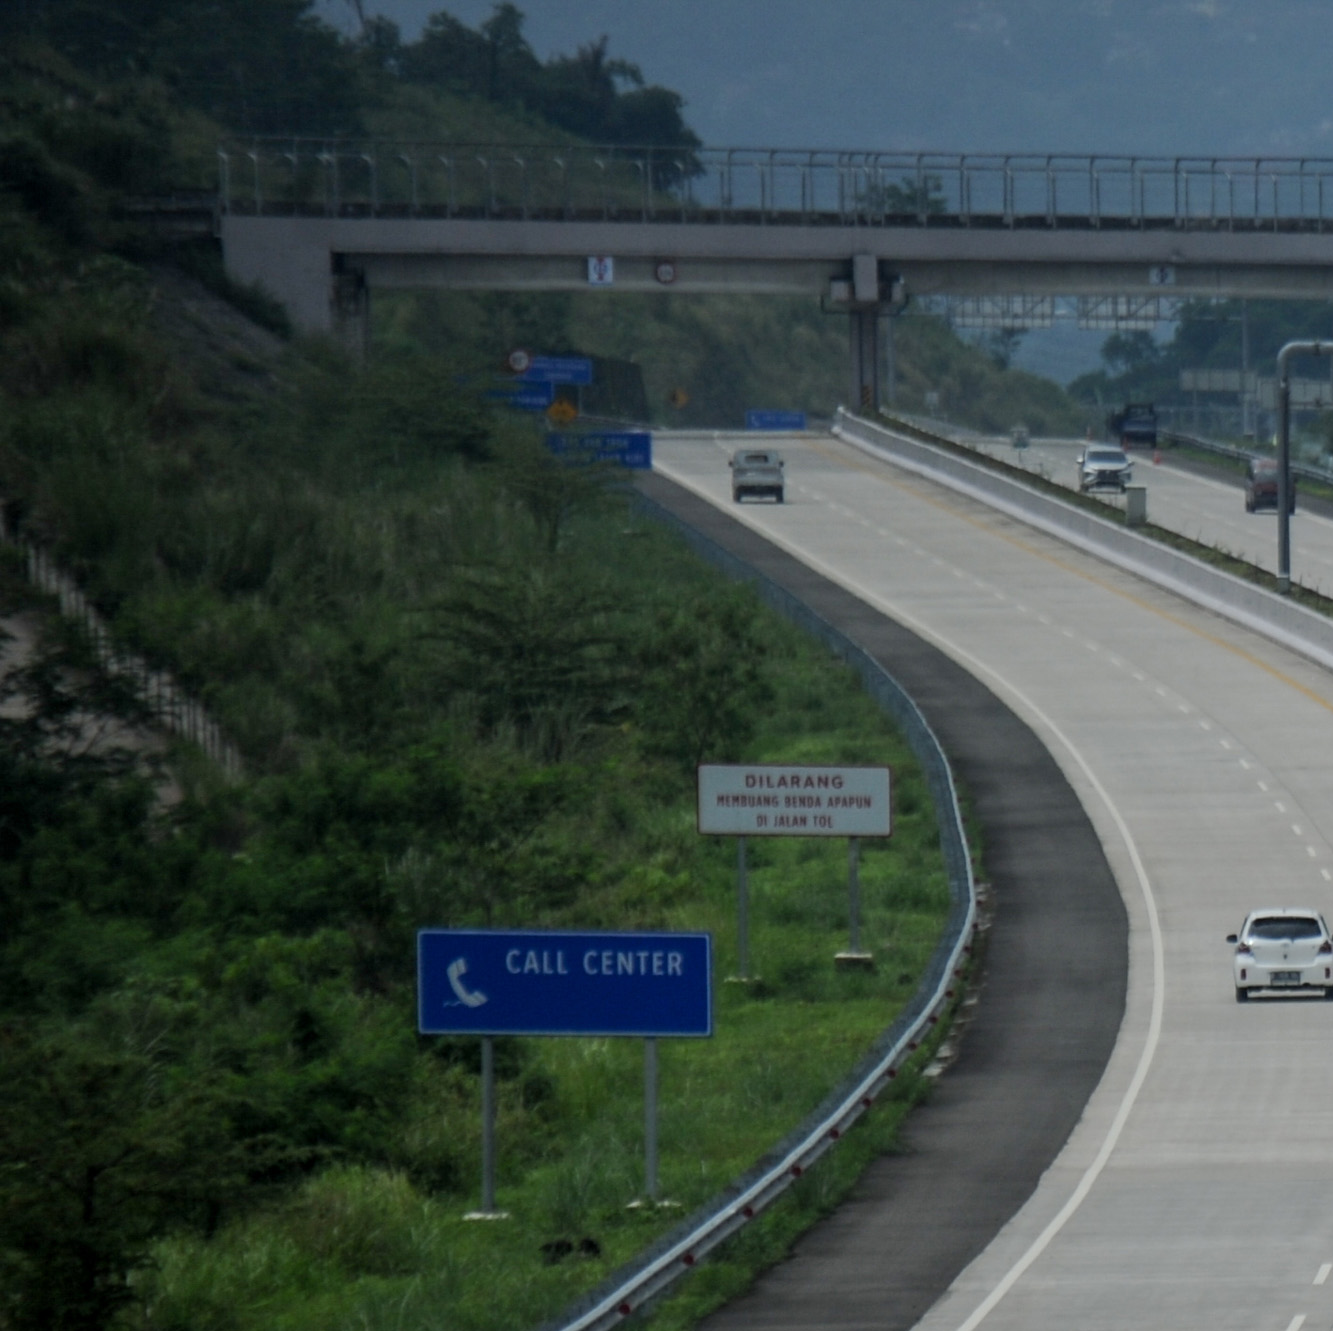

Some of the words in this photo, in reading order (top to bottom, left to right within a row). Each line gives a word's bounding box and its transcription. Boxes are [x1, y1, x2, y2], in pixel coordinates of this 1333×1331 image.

[745, 774, 844, 789] DILARANG
[717, 794, 779, 807] MEMBUANG
[784, 795, 821, 809] BENDA
[827, 795, 872, 809] APAPUN
[756, 815, 767, 828] DI
[773, 815, 807, 828] JALAN
[813, 815, 834, 828] TOL
[505, 949, 568, 975] CALL
[583, 951, 683, 976] CENTER
